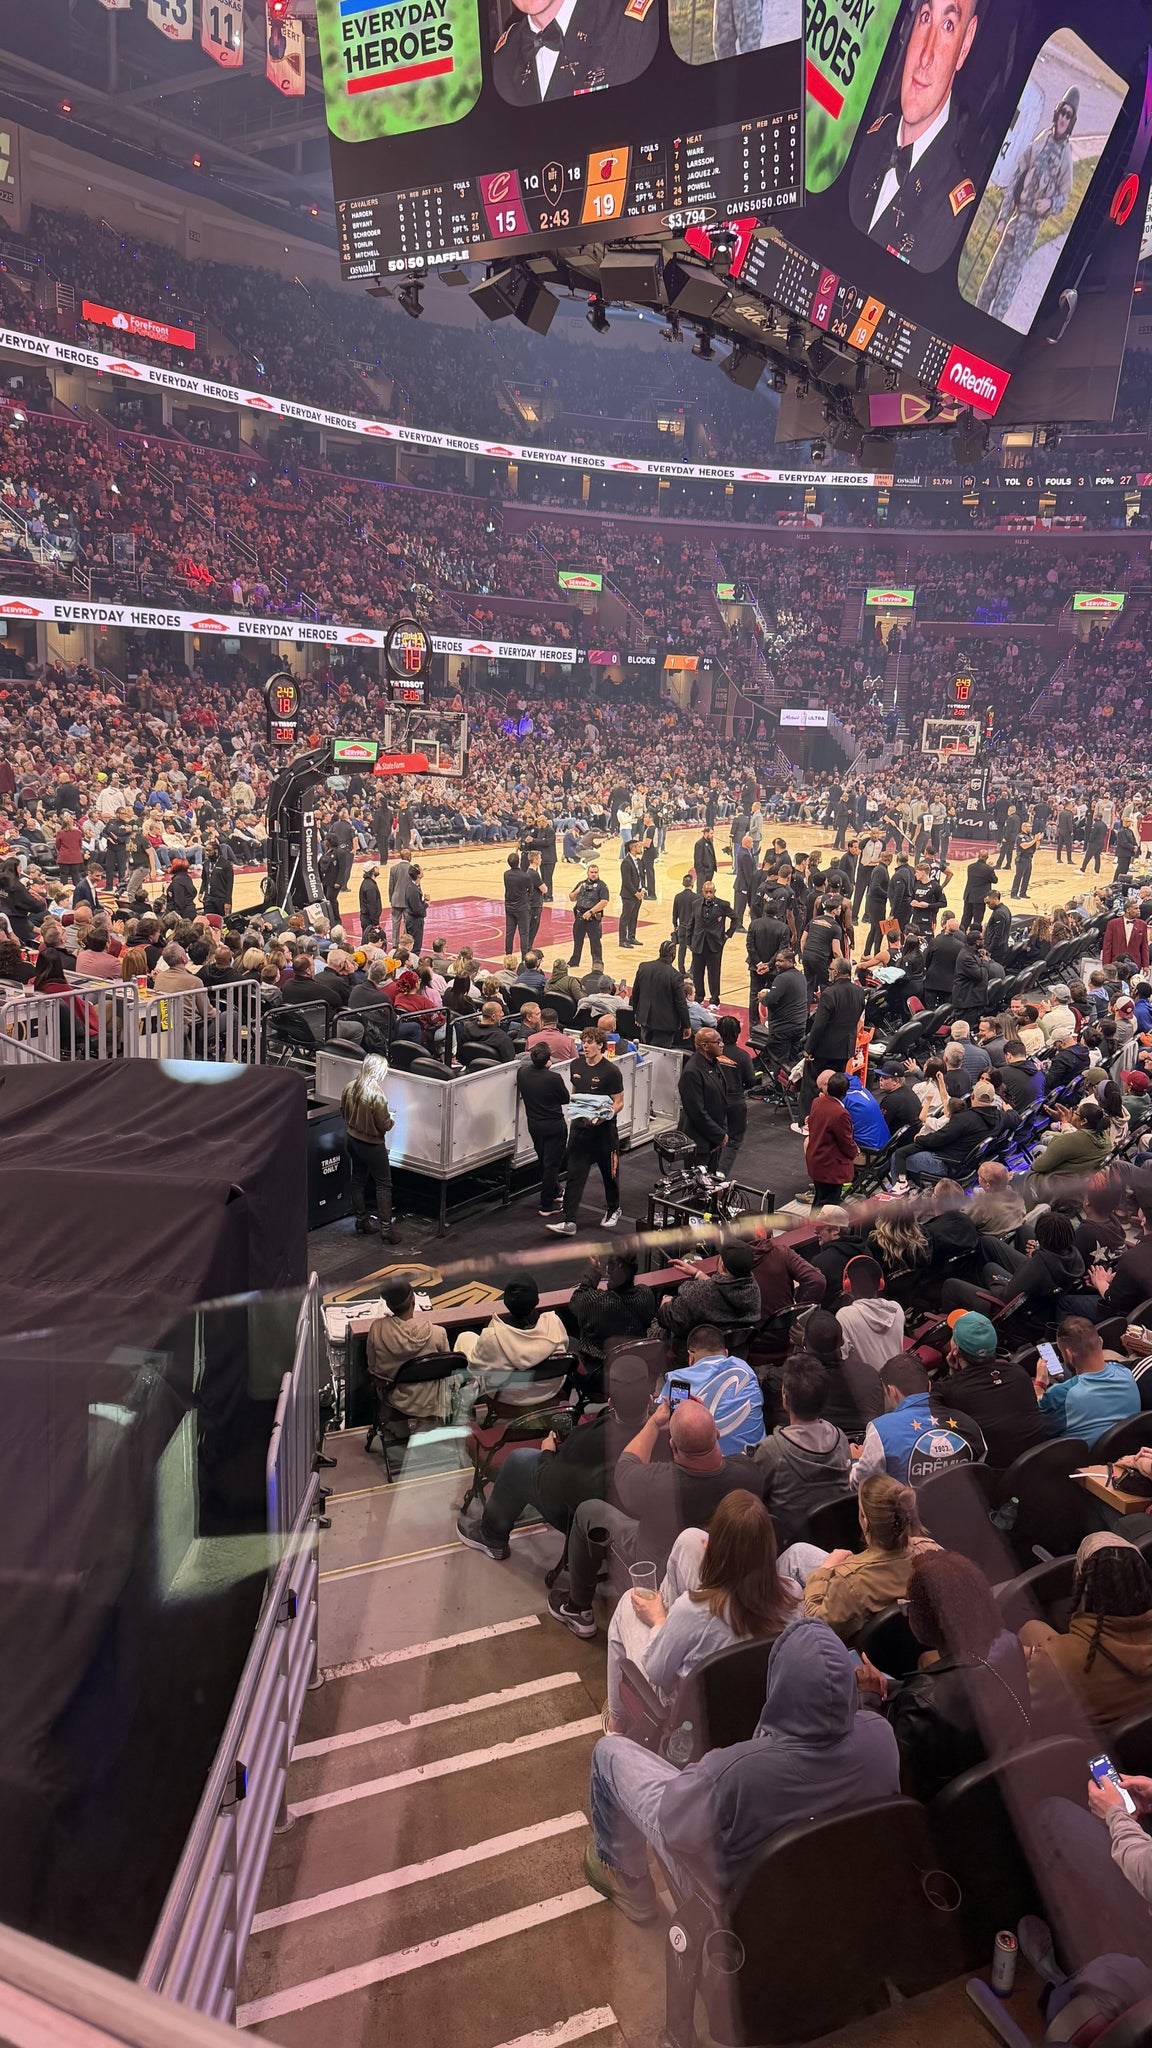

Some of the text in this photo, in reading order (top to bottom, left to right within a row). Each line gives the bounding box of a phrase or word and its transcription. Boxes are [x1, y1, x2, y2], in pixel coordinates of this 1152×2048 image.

[342, 0, 447, 41] EVERYDAY
[210, 6, 236, 51] 11
[343, 23, 453, 74] HEROES
[806, 0, 861, 86] ROES
[686, 113, 798, 144] HEAT PTS REB AST FLS
[640, 144, 659, 154] FOULS
[686, 146, 704, 157] WARE
[687, 156, 714, 168] LARSSON
[790, 138, 795, 146] 0
[647, 152, 652, 162] 4
[743, 161, 748, 169] 0
[774, 154, 779, 162] 0
[568, 167, 581, 181] 18
[687, 181, 711, 192] POWELL
[774, 166, 779, 174] 0
[453, 181, 470, 190] FOULS
[524, 175, 539, 190] 1Q
[656, 178, 664, 187] 44
[688, 192, 717, 203] MITCHELL
[743, 185, 748, 193] 2
[760, 181, 766, 190] 0
[350, 198, 378, 209] CAVALIERS
[593, 194, 614, 217] 19
[627, 204, 656, 216] TOL CH
[726, 192, 797, 215] CAVS5050.COM
[471, 212, 478, 220] 27
[496, 210, 516, 233] 15
[540, 209, 569, 229] 2:43
[668, 209, 706, 230] $3,794
[427, 250, 469, 265] RAFFLE
[350, 260, 376, 274] oswald
[816, 303, 827, 322] 15
[130, 317, 168, 336] ForeFront
[831, 319, 847, 338] 2:43
[856, 328, 866, 344] 19
[150, 371, 198, 391] EVERYDAY
[959, 367, 997, 401] Redfin
[281, 404, 321, 422] EVERYDAY
[399, 430, 442, 445] EVERYDAY
[521, 450, 567, 464] EVERYDAY
[647, 464, 695, 475] EVERYDAY
[779, 474, 826, 483] EVERYDAY
[897, 476, 920, 484] oswald
[1026, 478, 1033, 487] 6
[1078, 478, 1084, 486] 3
[1120, 476, 1132, 485] 27
[2, 606, 32, 614] SERVPRO
[54, 606, 124, 622] EVERYDAY
[198, 622, 222, 631] SERVPRO
[239, 622, 294, 637] EVERYDAY
[406, 647, 421, 670] 18
[499, 647, 535, 659] EVERYDAY
[612, 655, 617, 663] 0
[628, 656, 656, 665] BLOCKS
[957, 687, 968, 699] 18
[280, 699, 290, 712] 18
[306, 828, 318, 898] Cleveland Clinic
[321, 1155, 340, 1166] TRASH
[323, 1165, 338, 1175] ONLY
